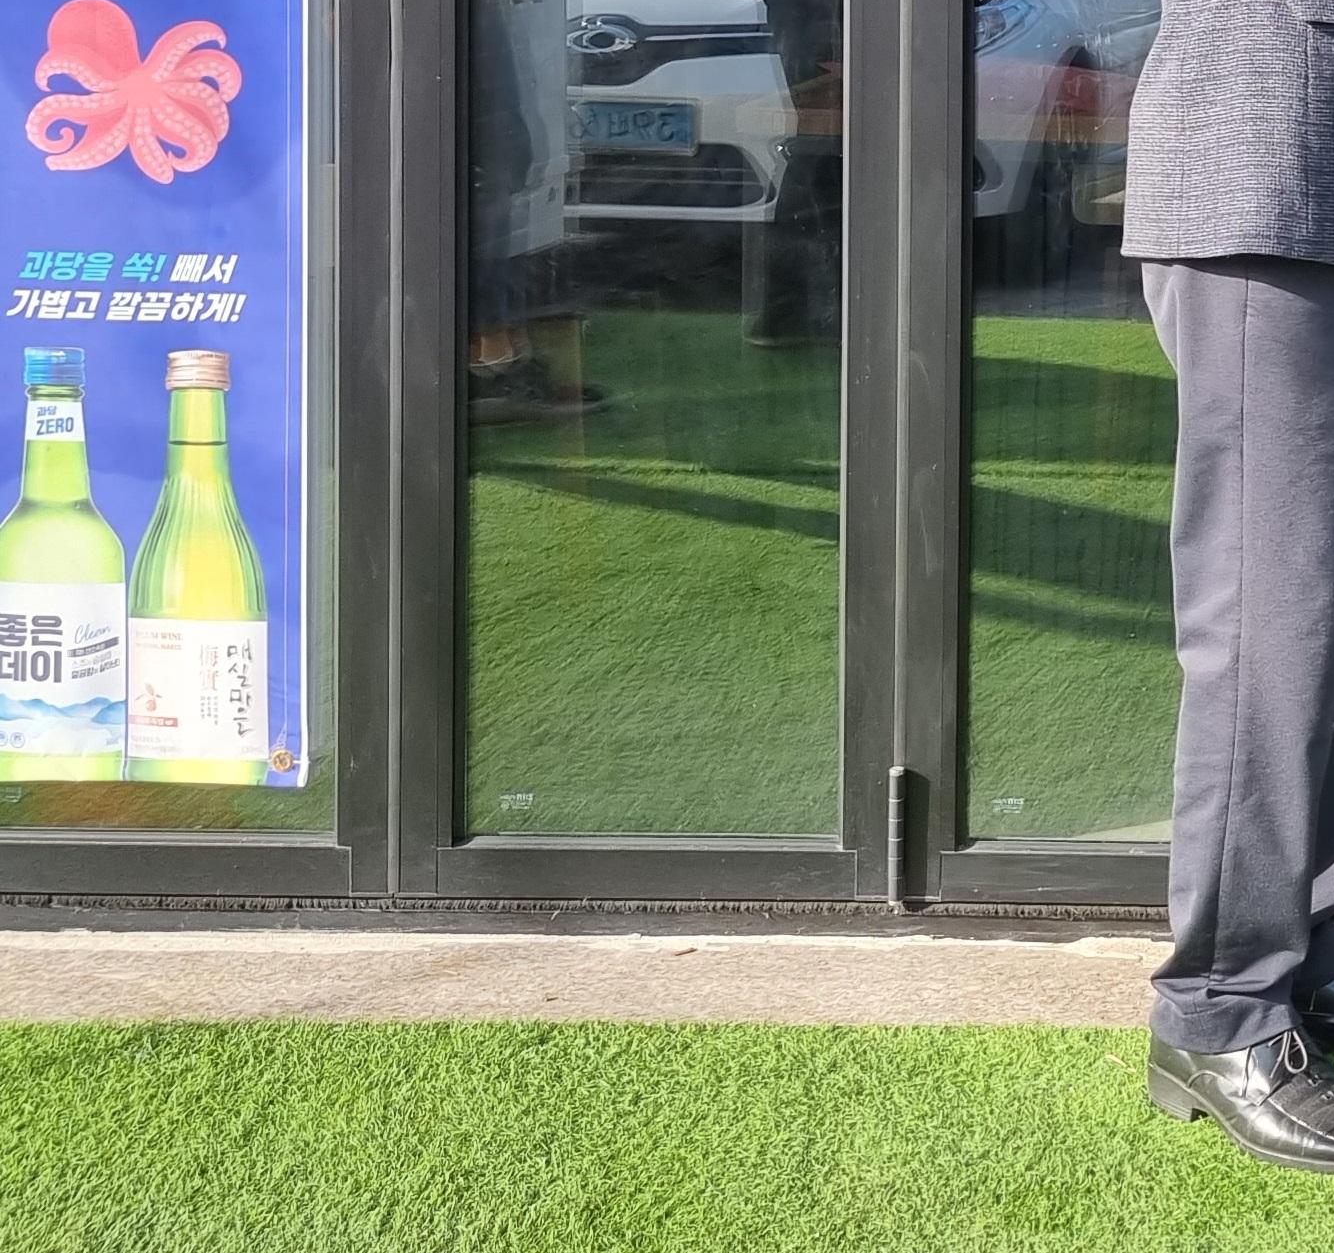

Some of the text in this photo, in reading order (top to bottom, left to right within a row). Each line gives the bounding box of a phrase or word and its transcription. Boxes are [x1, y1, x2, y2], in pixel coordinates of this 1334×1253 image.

[18, 251, 114, 282] 과당을
[169, 253, 238, 284] 빼서
[6, 289, 247, 322] 가볍고 깔끔하게!
[36, 417, 74, 436] ZERO
[0, 613, 63, 647] 좋은
